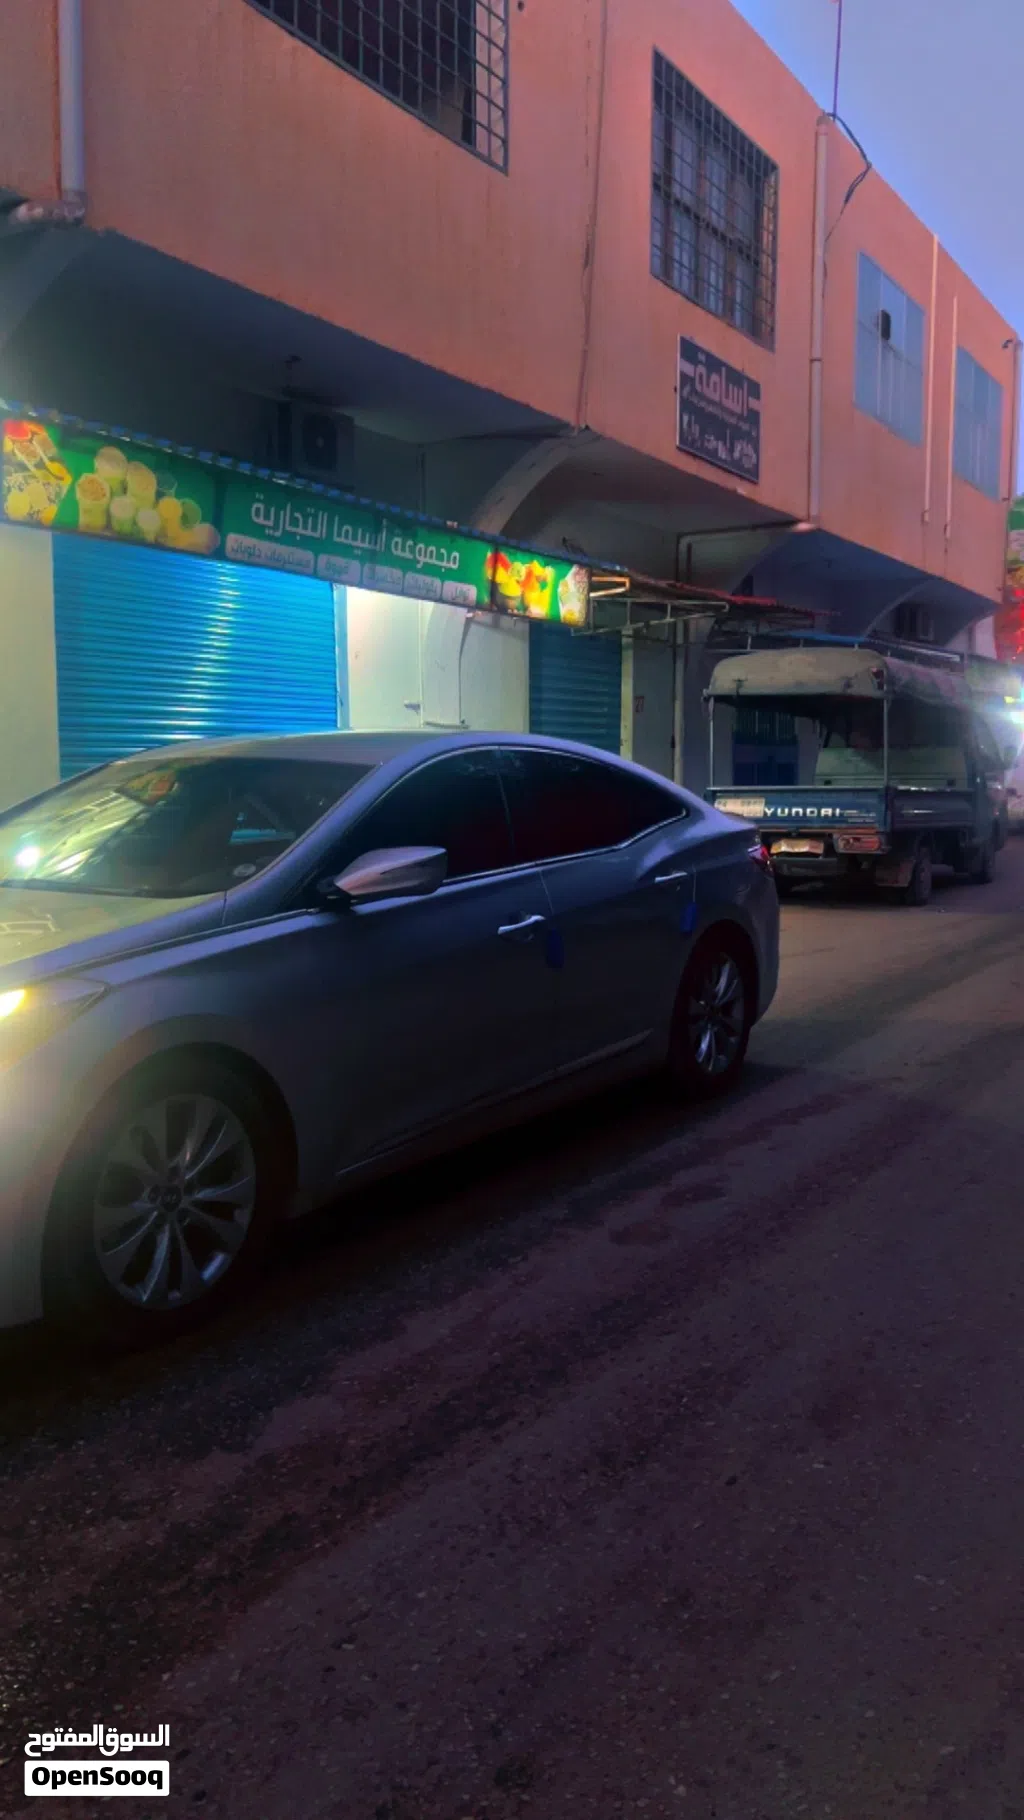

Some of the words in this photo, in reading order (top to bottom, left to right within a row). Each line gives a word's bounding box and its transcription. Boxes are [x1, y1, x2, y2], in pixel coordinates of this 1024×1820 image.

[251, 492, 329, 541] التجارية
[333, 514, 387, 556] أسيما
[391, 529, 460, 572] مجموعة
[764, 807, 840, 818] YUNDAI
